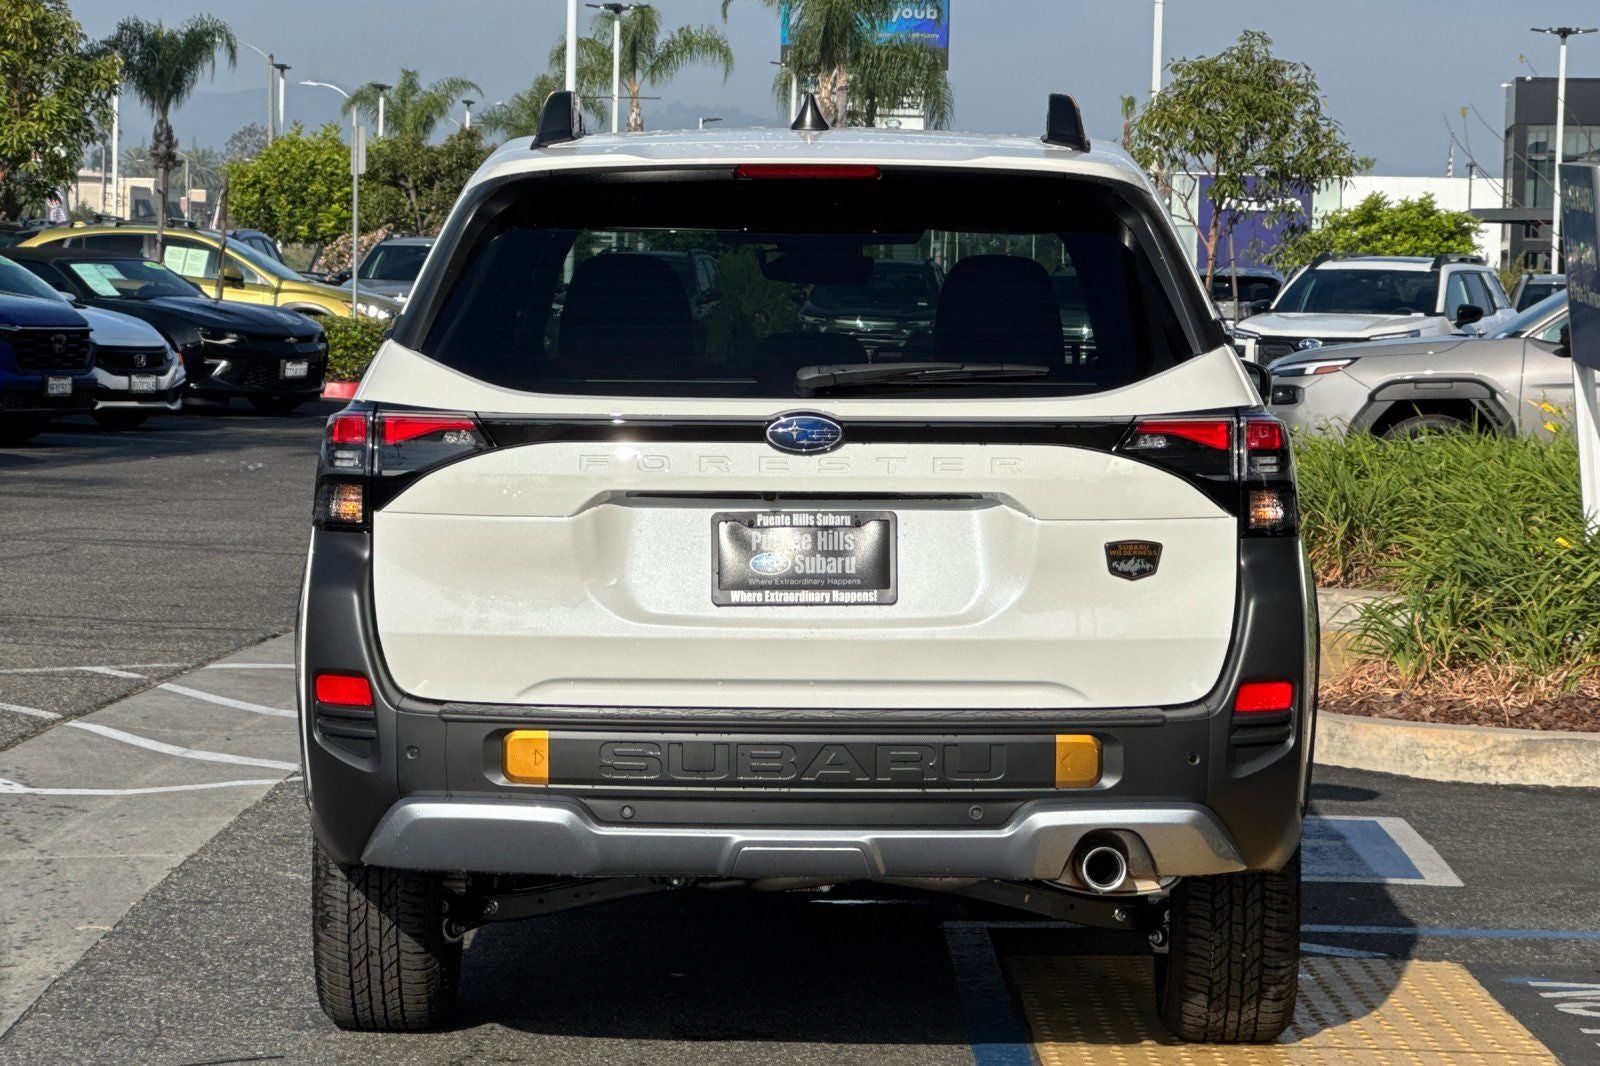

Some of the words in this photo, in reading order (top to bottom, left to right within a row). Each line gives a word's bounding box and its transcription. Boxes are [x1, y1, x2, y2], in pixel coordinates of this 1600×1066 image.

[578, 453, 1024, 475] FORESTER
[756, 513, 791, 526] Puente
[793, 513, 814, 526] Hills
[816, 513, 851, 526] Subaru
[817, 530, 855, 551] Hills
[794, 554, 856, 574] Subaru
[748, 577, 773, 586] Where
[774, 577, 825, 587] Extraordinary
[827, 577, 862, 587] Happens
[731, 590, 763, 603] Where
[765, 590, 831, 603] Extraordinary
[832, 590, 878, 603] Happens!
[598, 741, 1008, 781] SUBARU
